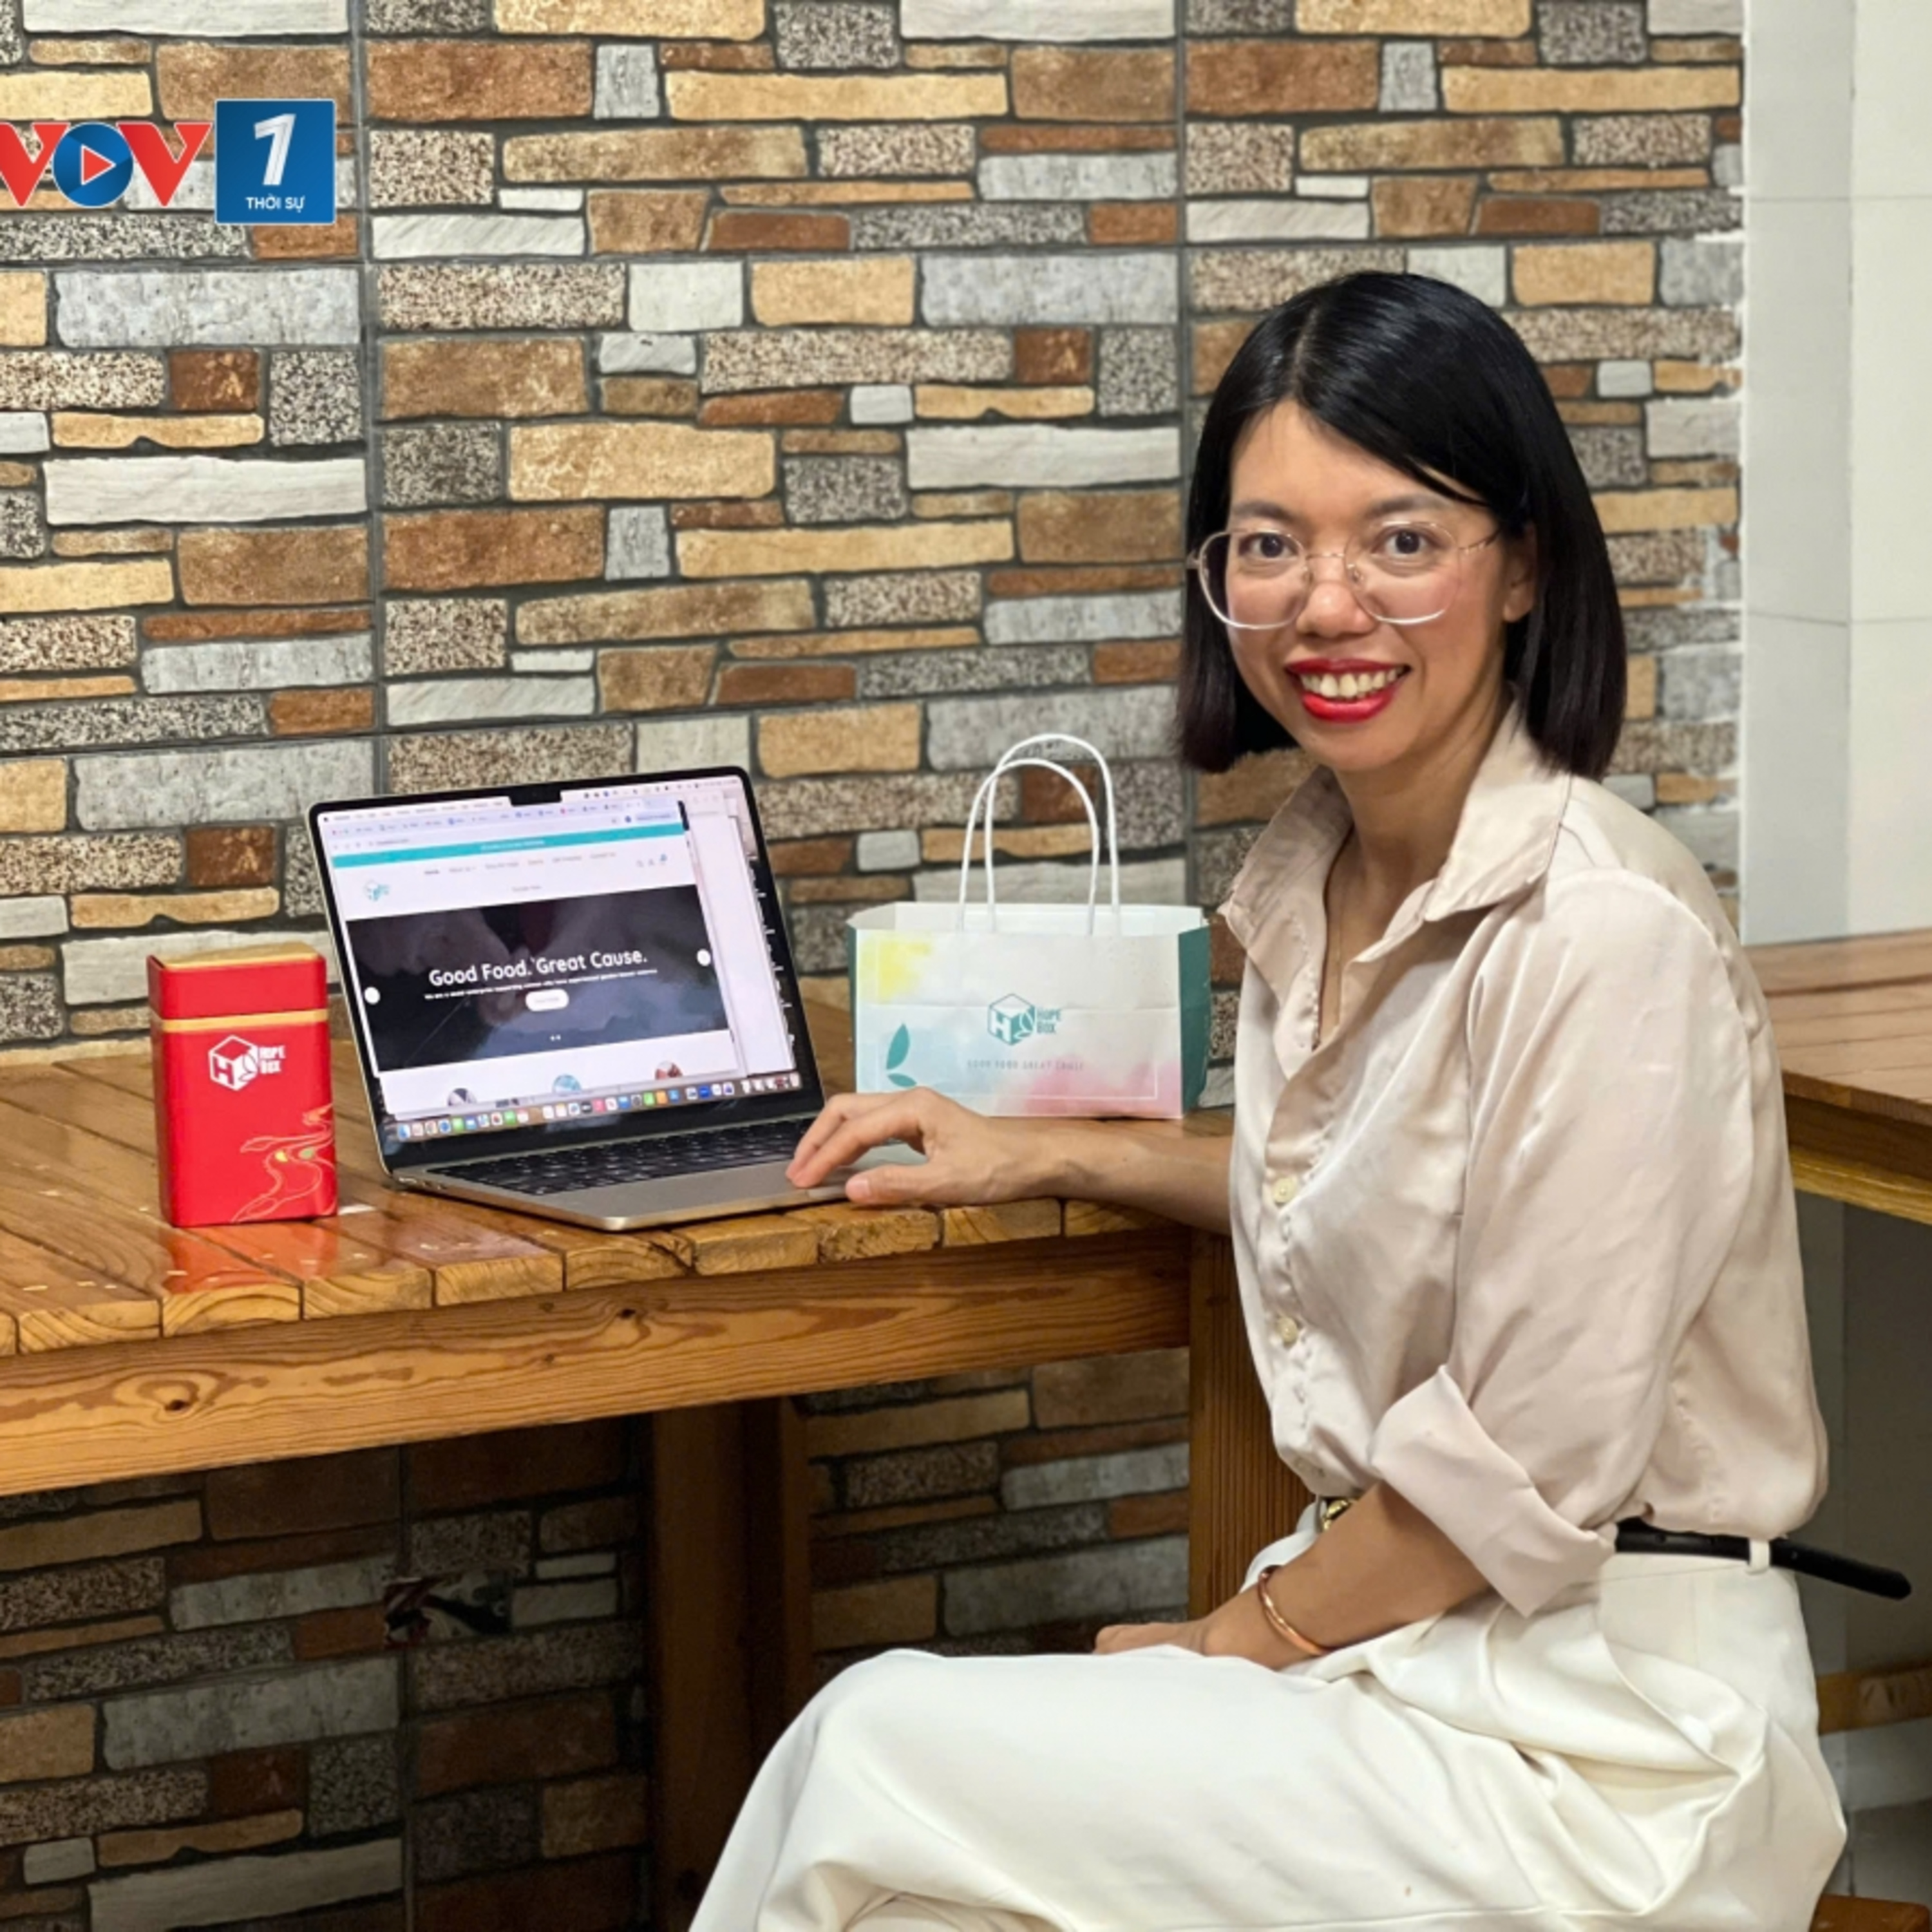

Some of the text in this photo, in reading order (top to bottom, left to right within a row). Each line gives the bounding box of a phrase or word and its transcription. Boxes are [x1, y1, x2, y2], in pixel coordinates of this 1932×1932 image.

[428, 965, 478, 987] Good
[482, 960, 532, 981] Food.
[535, 954, 587, 975] Great
[590, 950, 647, 968] Cause.
